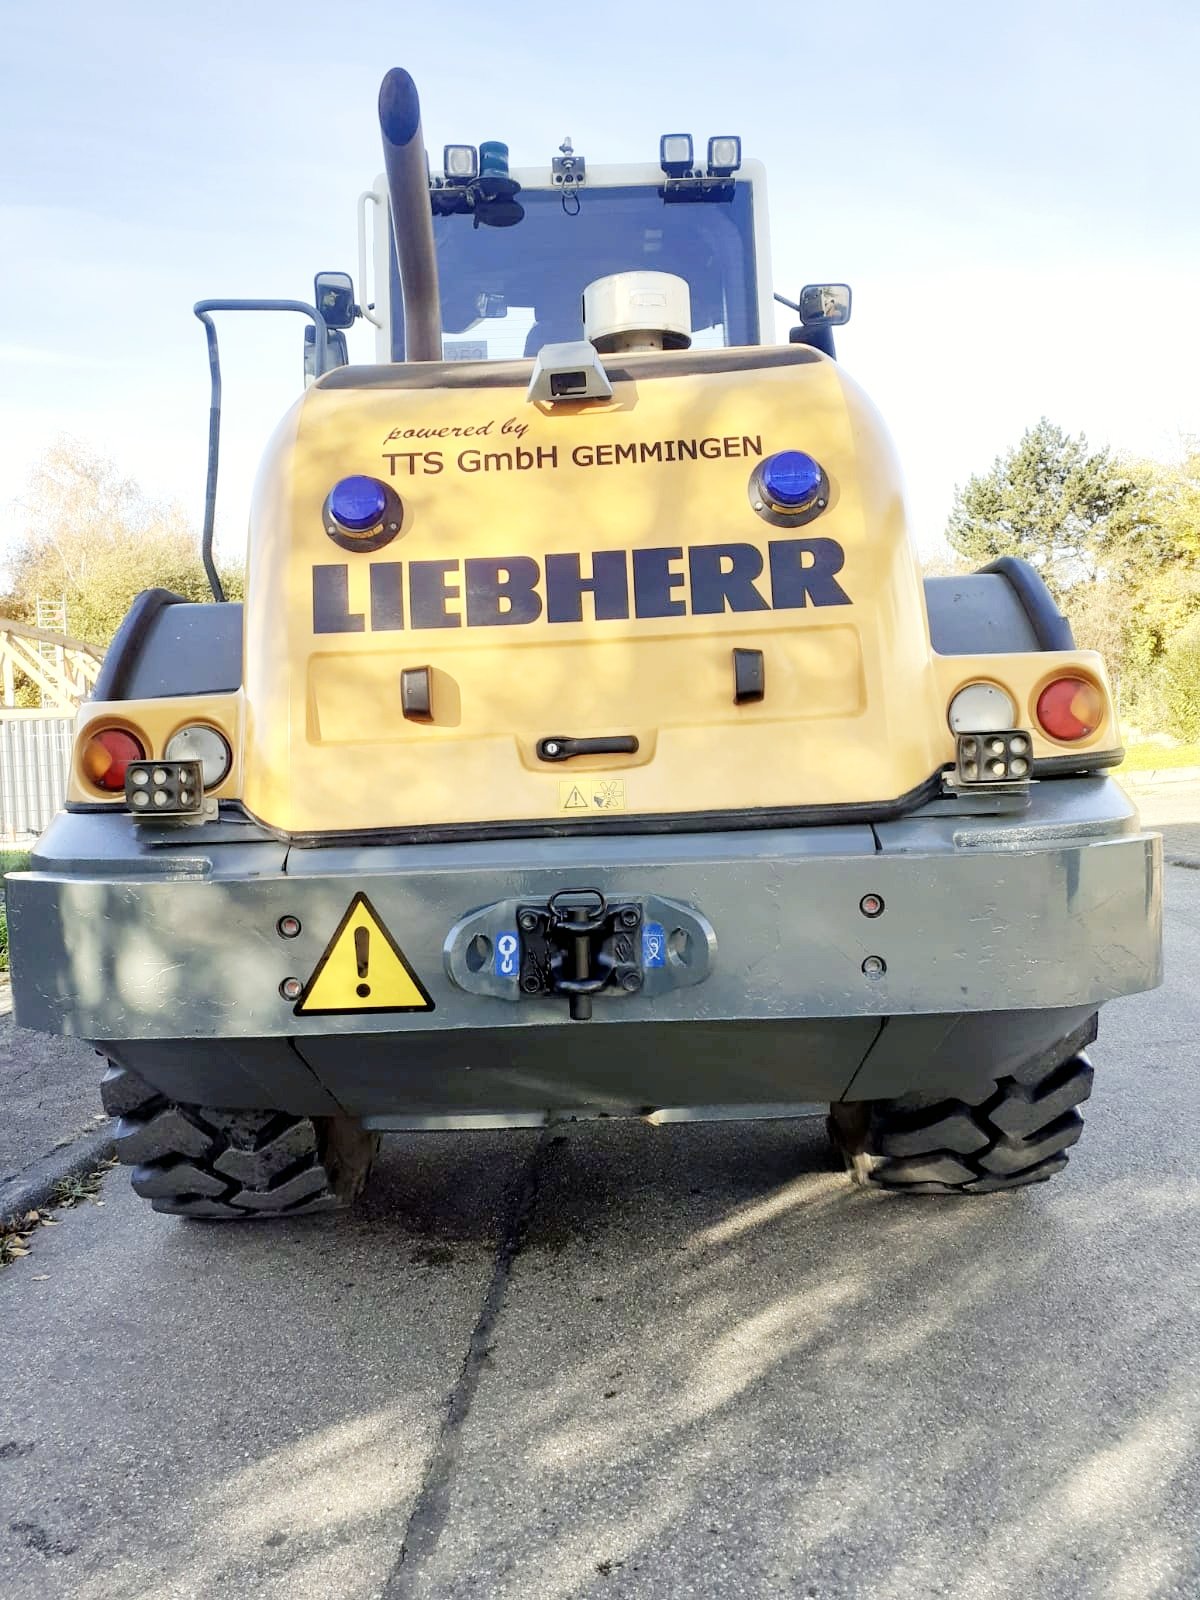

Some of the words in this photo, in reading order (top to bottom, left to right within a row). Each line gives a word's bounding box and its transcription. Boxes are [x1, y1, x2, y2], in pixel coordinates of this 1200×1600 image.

[382, 420, 495, 445] powered
[501, 416, 530, 439] by
[382, 451, 444, 476] TTS
[457, 445, 558, 473] GmbH
[571, 435, 763, 467] GEMMINGEN
[312, 537, 853, 634] LIEBHERR
